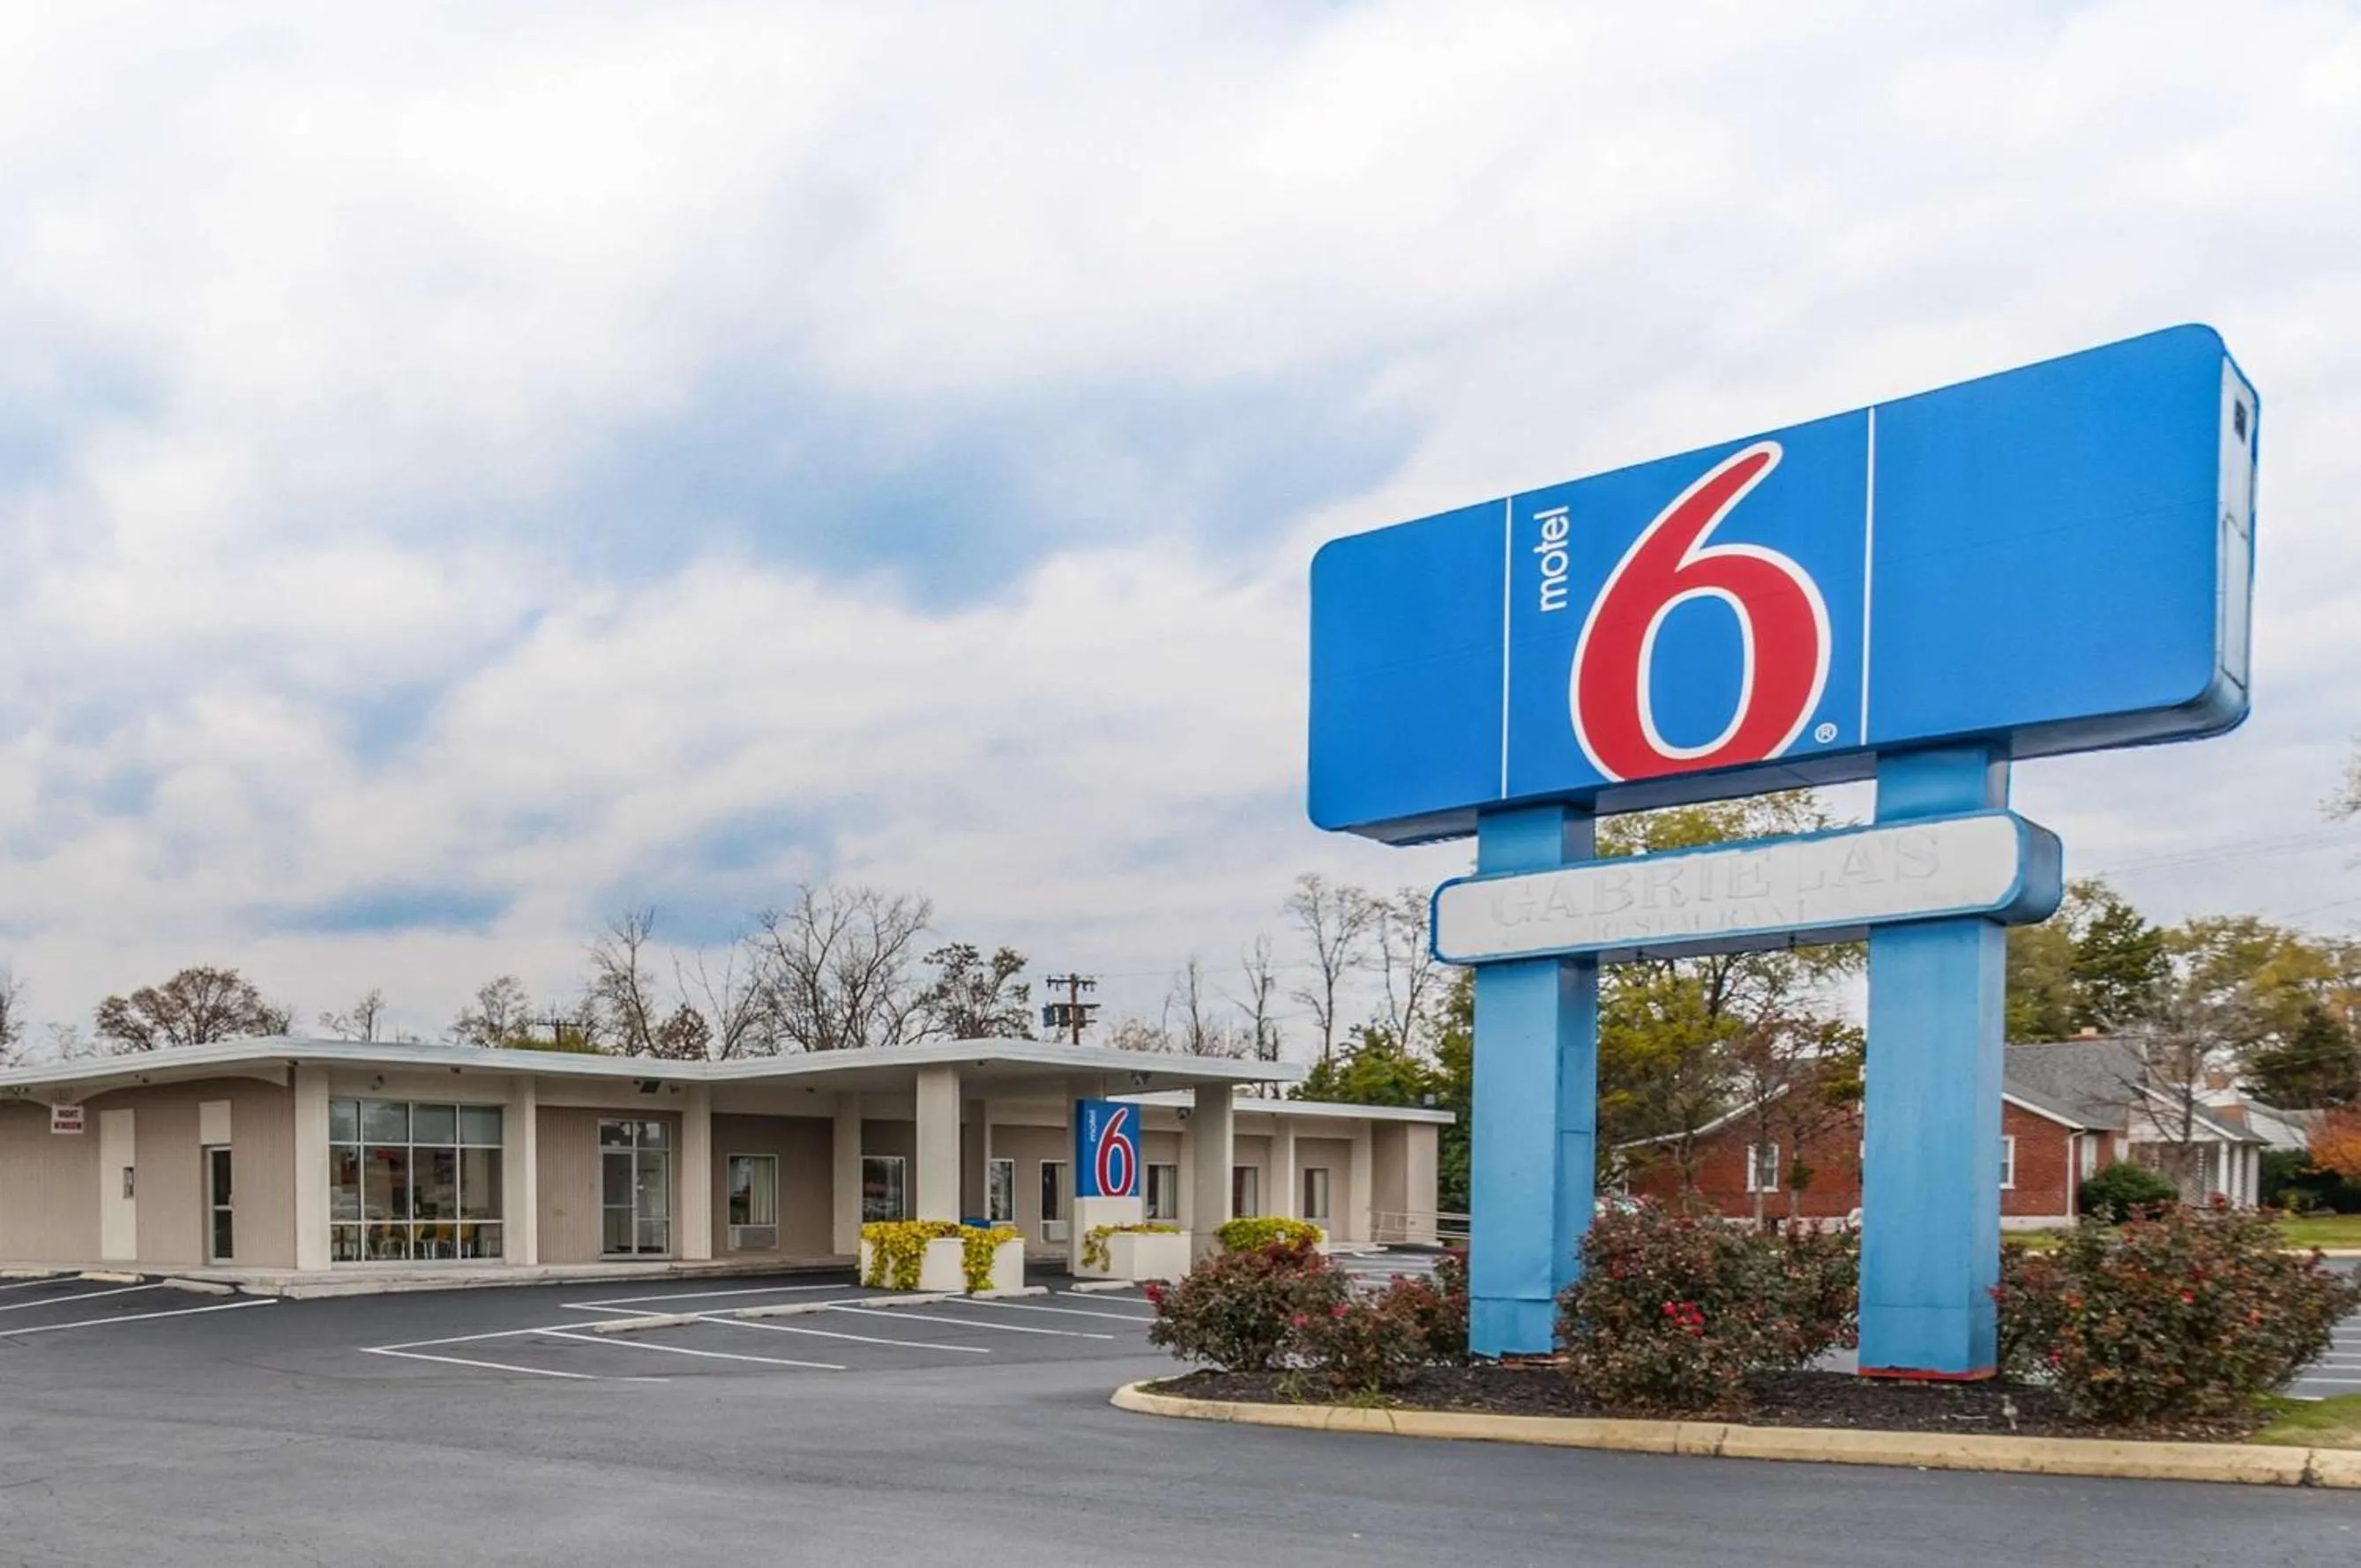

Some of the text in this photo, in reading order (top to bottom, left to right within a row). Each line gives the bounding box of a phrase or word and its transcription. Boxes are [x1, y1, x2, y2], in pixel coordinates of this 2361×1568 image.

[1533, 504, 1570, 612] motel
[1569, 440, 1832, 782] 6
[1095, 1107, 1136, 1197] 6
